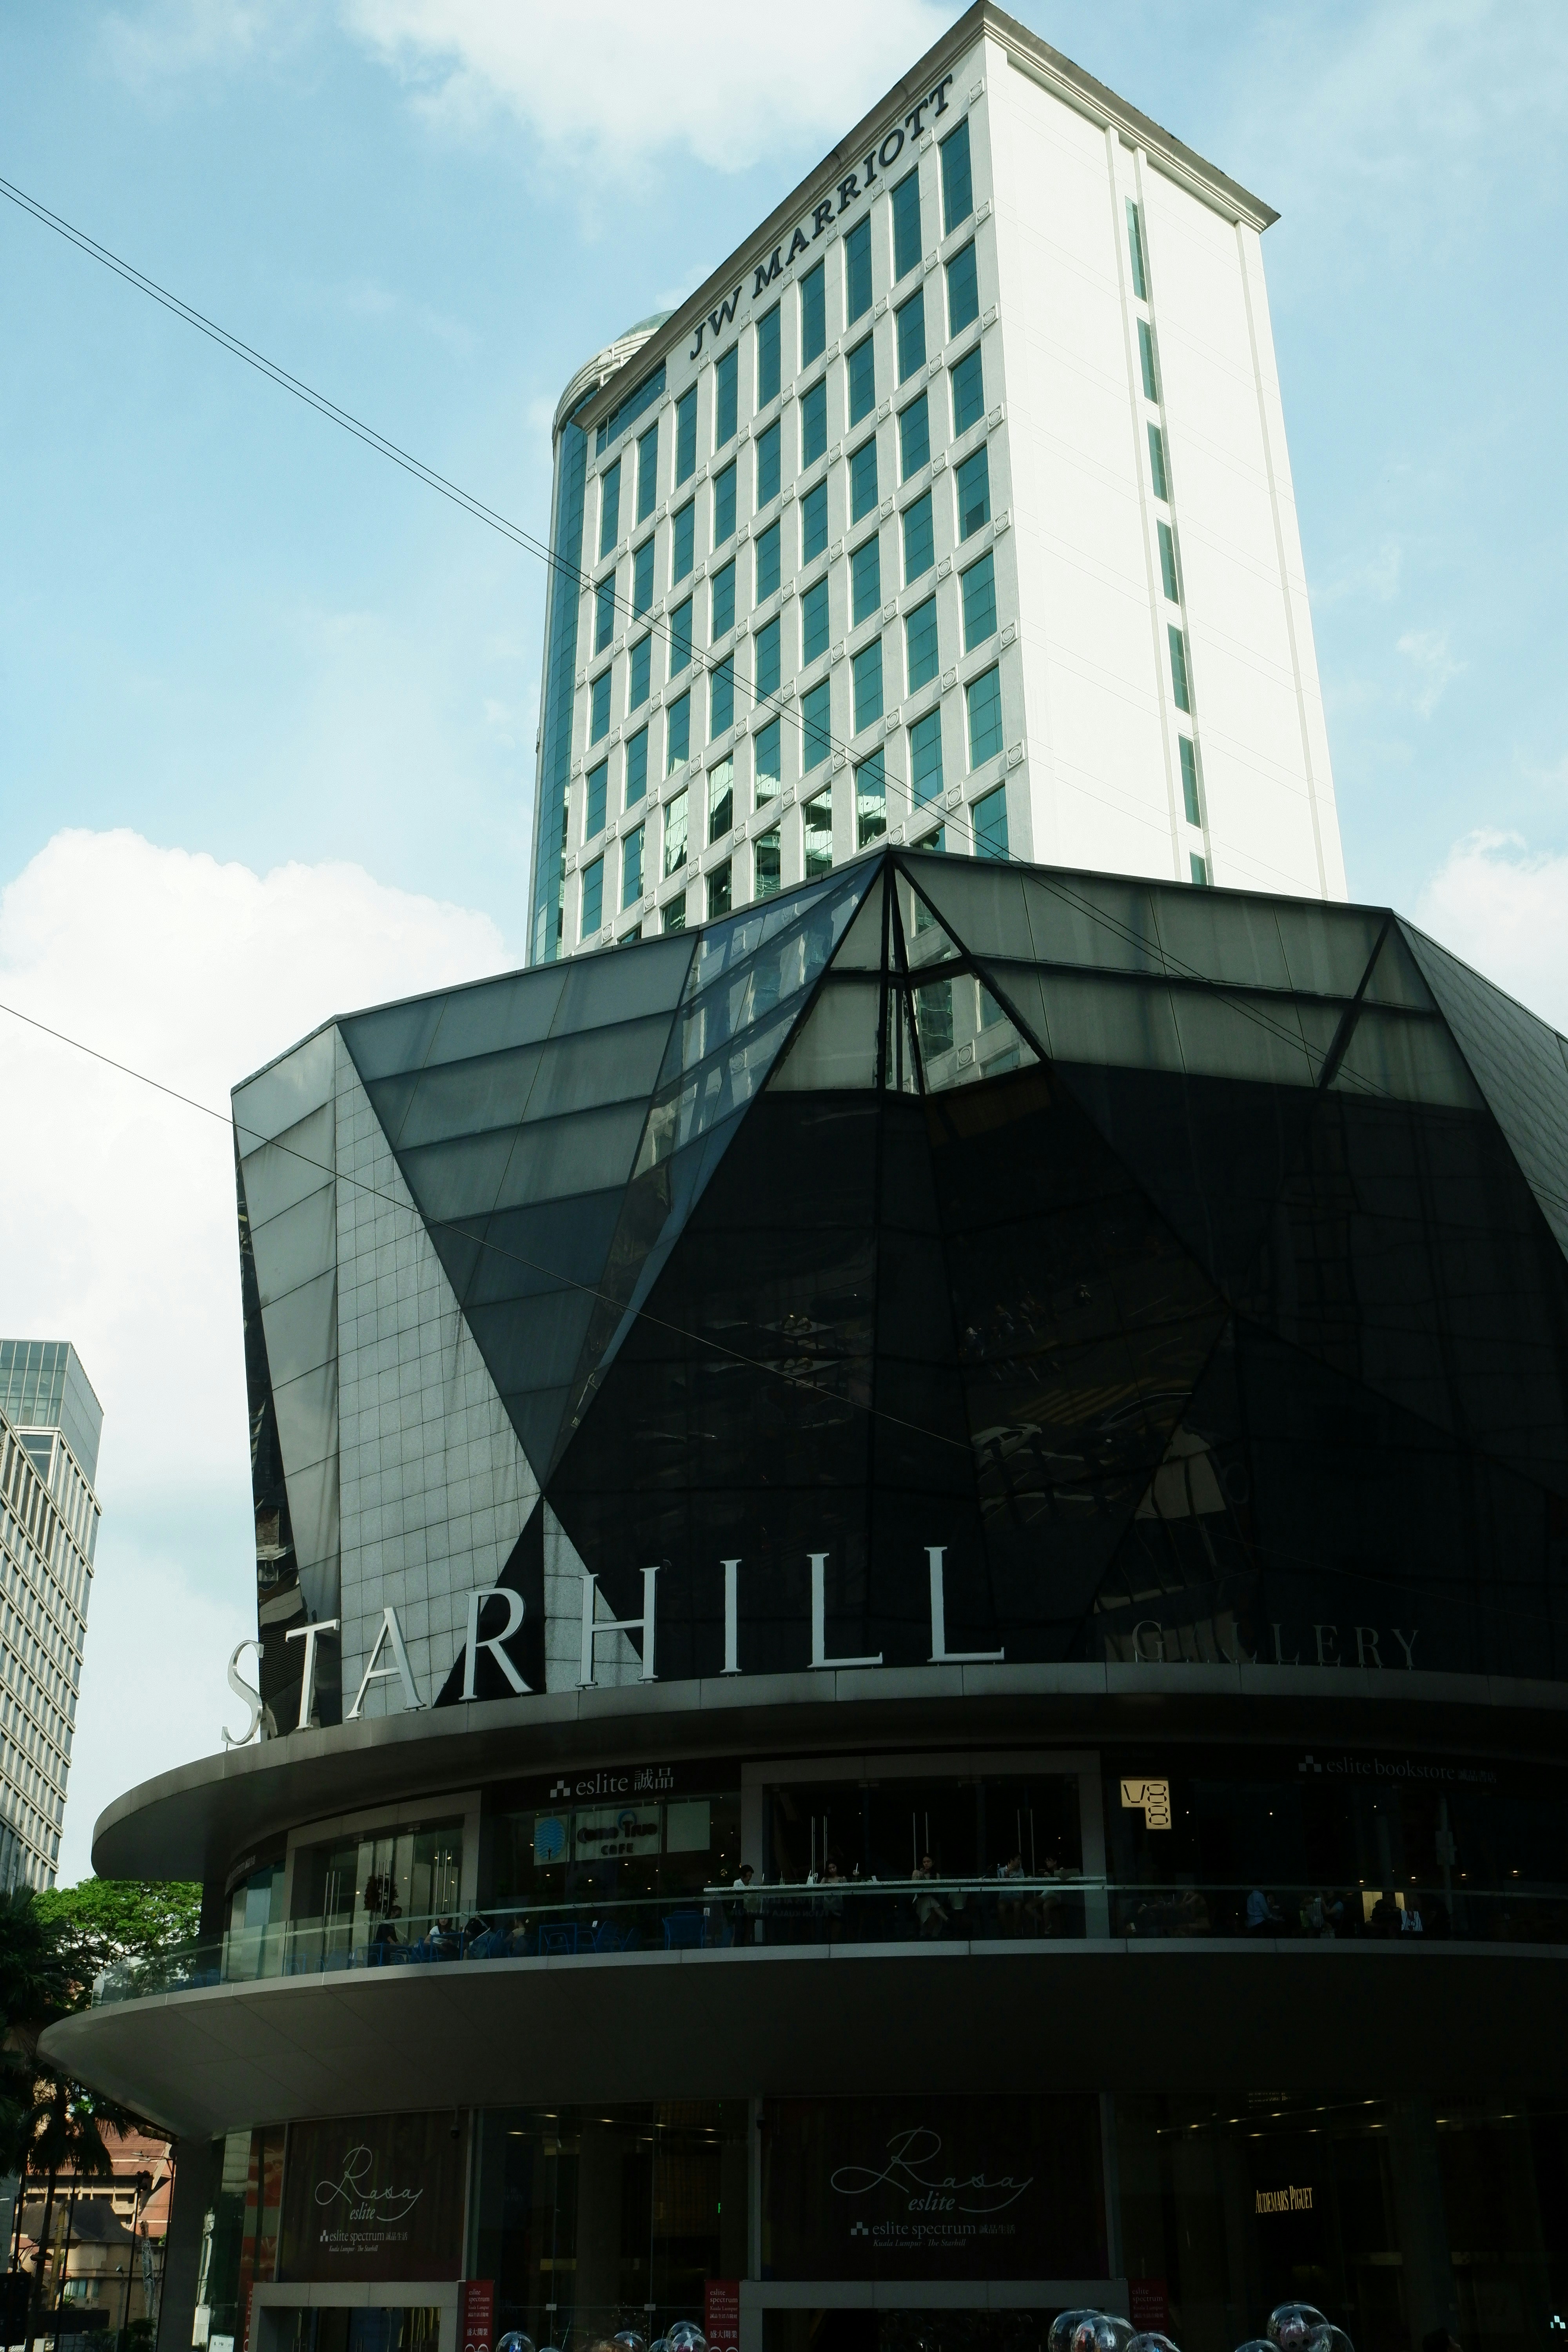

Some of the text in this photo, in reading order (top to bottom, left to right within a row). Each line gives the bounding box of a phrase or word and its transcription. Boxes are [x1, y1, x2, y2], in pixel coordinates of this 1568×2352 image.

[690, 73, 953, 360] JW MARRIOTT
[221, 1546, 1005, 1745] STARHILL
[1326, 1756, 1371, 1774] eslite
[1374, 1758, 1455, 1780] bookstore
[576, 1767, 674, 1796] eslite 誠品
[908, 2190, 956, 2211] eslite
[1255, 2185, 1312, 2214] AUDEMARS PIGUET
[350, 2202, 376, 2220] eslite
[329, 2229, 349, 2241] eslite
[350, 2232, 385, 2245] spectrum
[872, 2221, 909, 2235] eslite
[911, 2225, 976, 2239] spectrum
[873, 2238, 967, 2249] Kuala Lumpur The Starhill
[1132, 2296, 1163, 2304] spectrum
